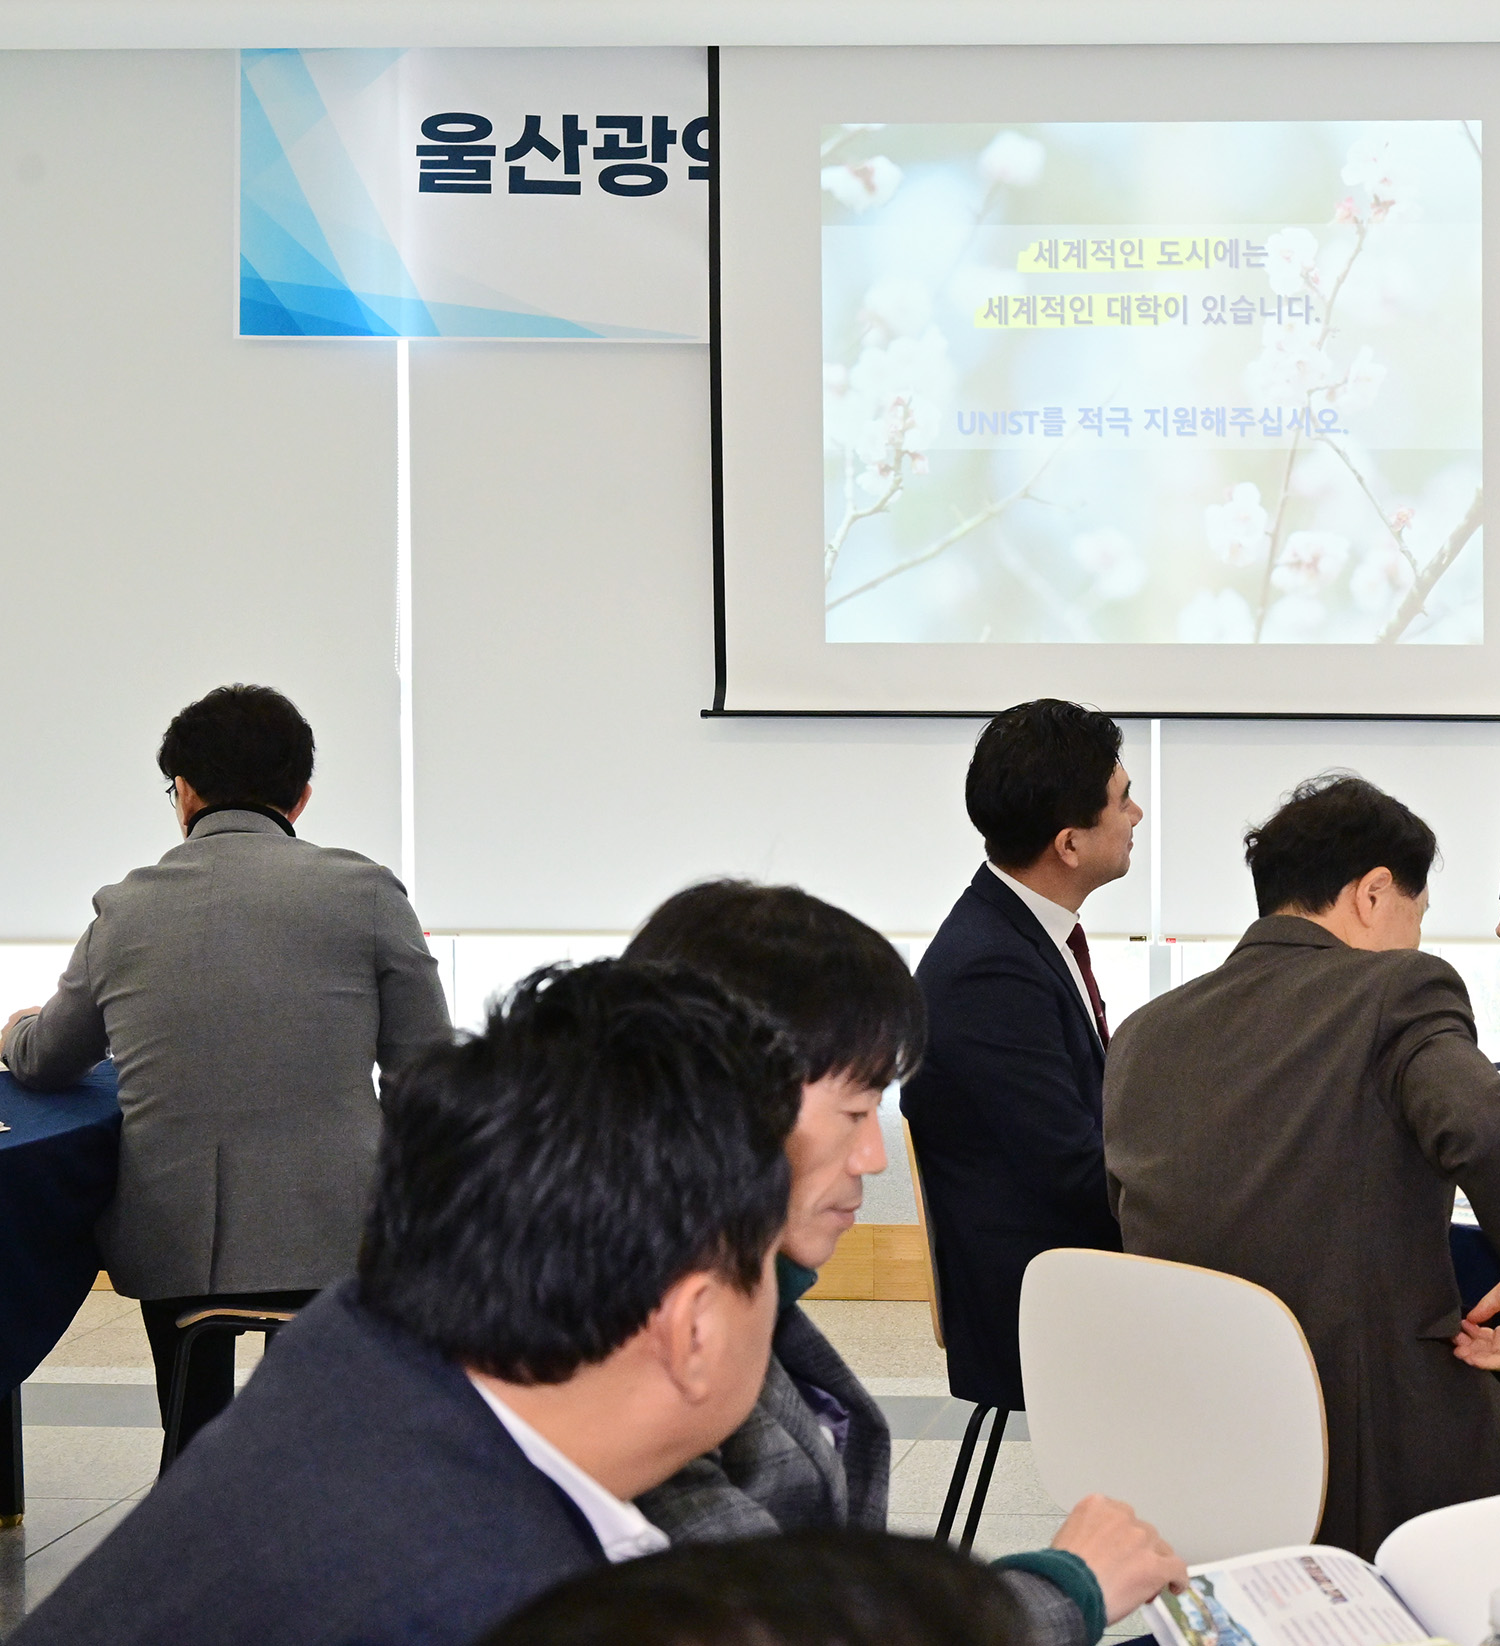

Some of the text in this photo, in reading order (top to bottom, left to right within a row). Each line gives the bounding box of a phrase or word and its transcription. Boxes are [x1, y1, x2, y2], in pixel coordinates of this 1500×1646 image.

[1033, 239, 1269, 269] 세계적인 도시에는
[983, 295, 1320, 326] 세계적인 대학이 있습니다.
[957, 407, 1349, 437] UNIST를 적극 지원해주십시오.
